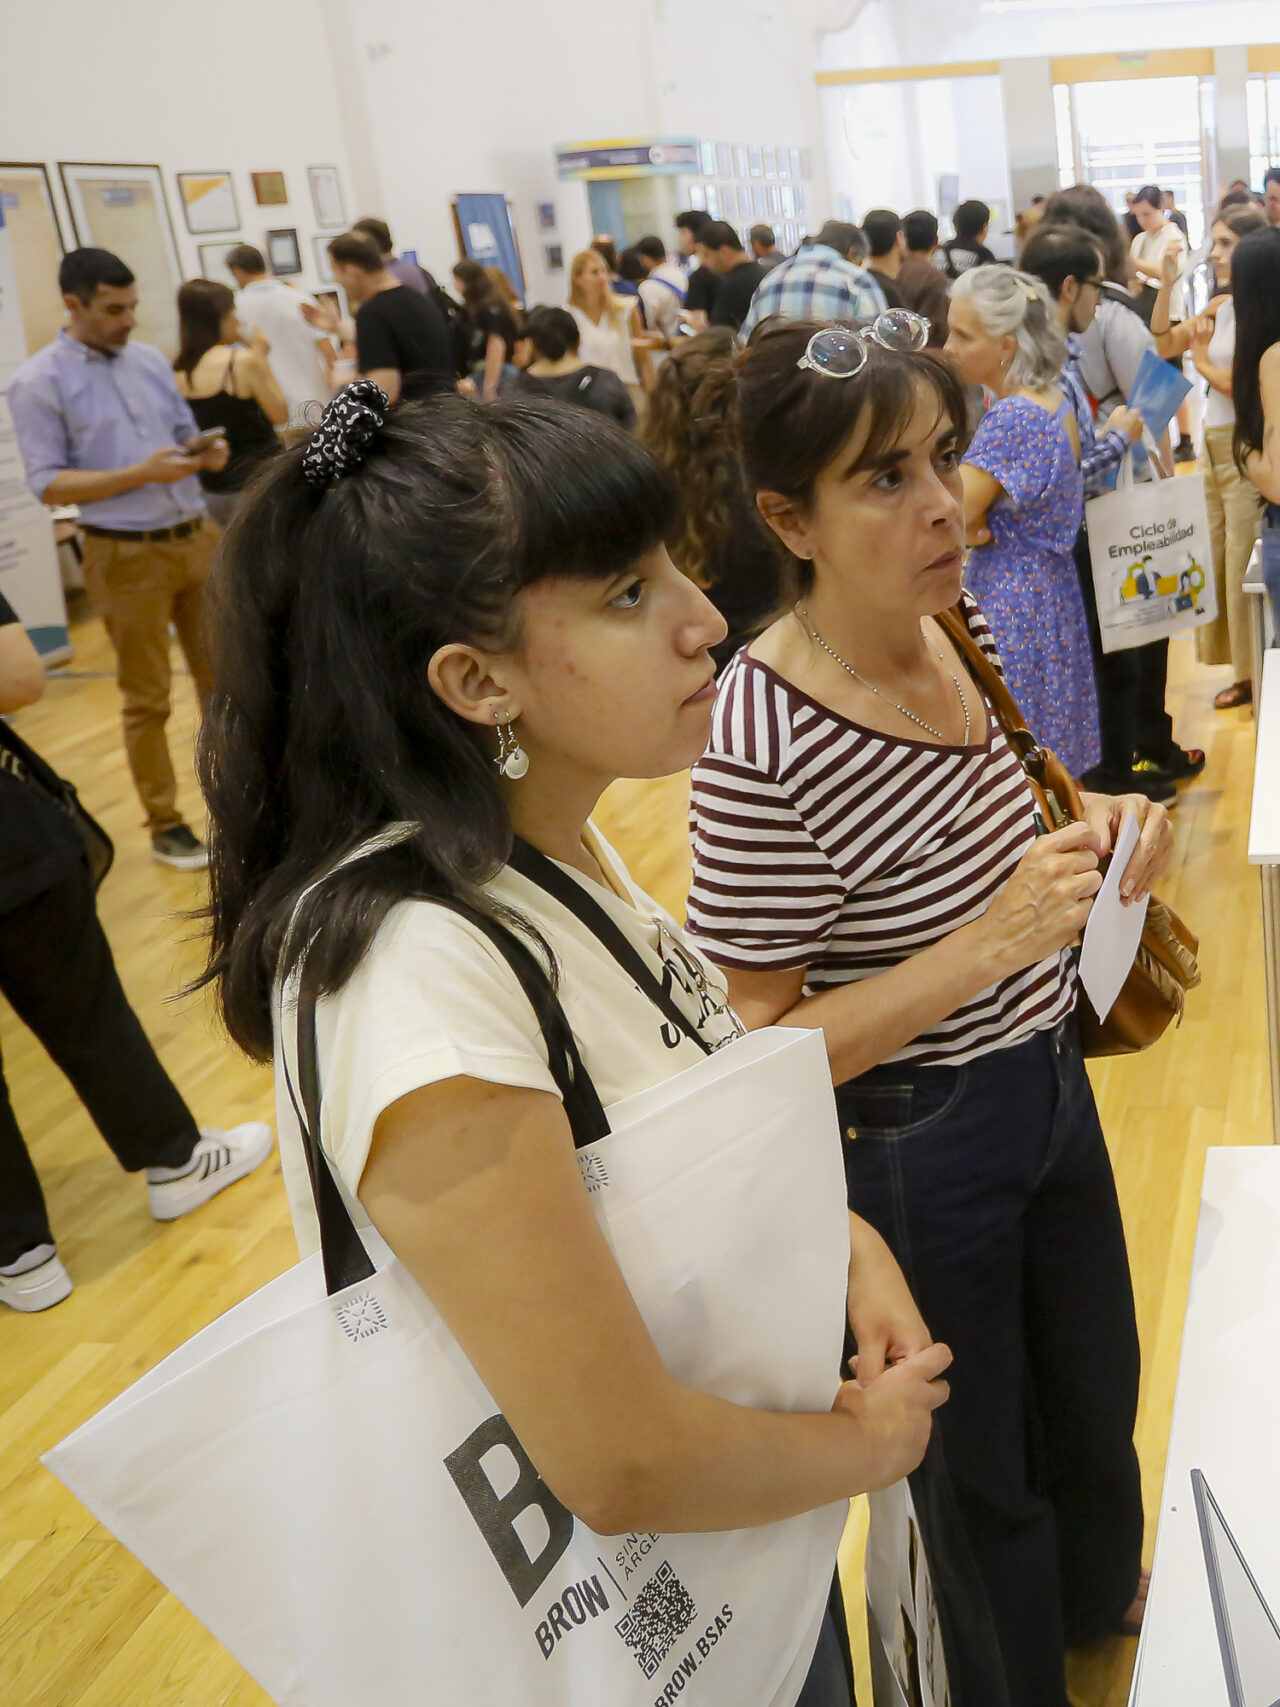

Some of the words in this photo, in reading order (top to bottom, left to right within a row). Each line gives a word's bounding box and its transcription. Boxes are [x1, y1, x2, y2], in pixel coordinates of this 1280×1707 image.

[1108, 523, 1194, 558] Empleabilidad
[1129, 522, 1165, 539] Ciclo
[616, 1532, 640, 1567] SIN
[534, 1574, 610, 1661] BROW
